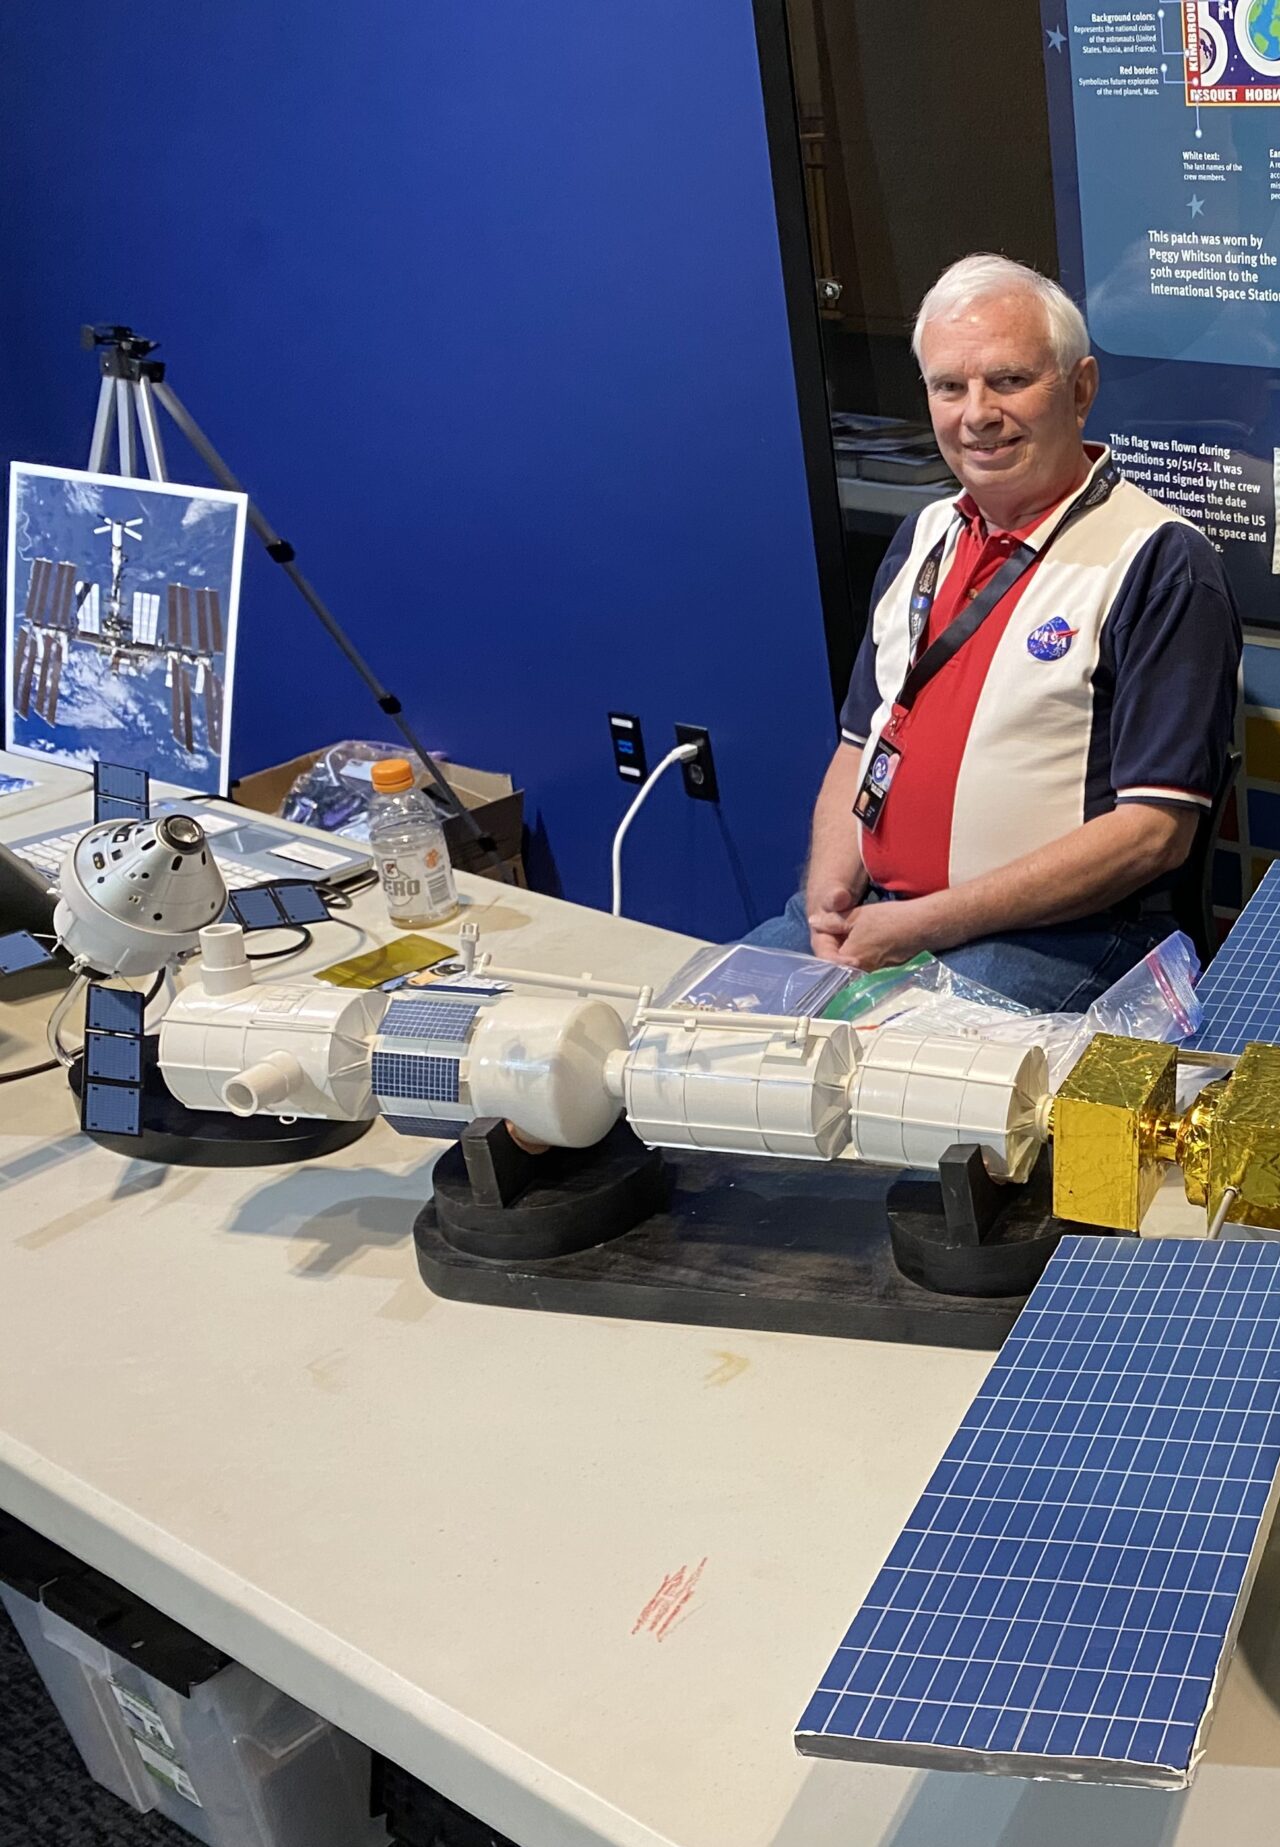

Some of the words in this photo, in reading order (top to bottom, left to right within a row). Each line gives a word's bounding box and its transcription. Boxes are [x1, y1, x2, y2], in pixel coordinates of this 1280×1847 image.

[1091, 13, 1131, 23] Background
[1190, 89, 1238, 102] PESQUET
[1182, 151, 1203, 160] White
[1203, 152, 1220, 160] text:
[1148, 230, 1169, 242] This
[1171, 232, 1198, 245] patch
[1200, 235, 1220, 244] was
[1222, 236, 1247, 246] worn
[1250, 234, 1263, 248] by
[1149, 248, 1179, 263] Peggy
[1180, 249, 1222, 262] Whitson
[1224, 251, 1258, 267] during
[1259, 252, 1277, 265] the
[1150, 266, 1172, 279] 50th
[1174, 268, 1226, 281] expedition
[1228, 270, 1239, 281] to
[1240, 270, 1258, 282] the
[1150, 283, 1214, 297] International
[1215, 286, 1246, 300] Space
[1109, 433, 1130, 446] This
[1130, 435, 1149, 450] flag
[1150, 440, 1169, 450] was
[1170, 440, 1197, 453] flown
[1198, 443, 1230, 459] during
[1110, 450, 1164, 465] Expeditions
[1166, 457, 1212, 472] 50/51/52.
[1213, 461, 1221, 472] It
[1222, 465, 1242, 474] was
[1152, 471, 1170, 482] and
[1172, 473, 1204, 486] signed
[1205, 476, 1218, 490] by
[1219, 478, 1235, 490] the
[1237, 482, 1260, 492] crew
[1146, 487, 1164, 498] and
[1166, 487, 1205, 502] includes
[1206, 493, 1223, 504] the
[1224, 495, 1246, 507] date
[1204, 508, 1231, 522] broke
[1233, 512, 1249, 524] the
[1251, 514, 1266, 526] US
[1206, 525, 1217, 536] in
[1218, 528, 1246, 540] space
[1248, 531, 1266, 542] and
[1031, 630, 1067, 649] NASA
